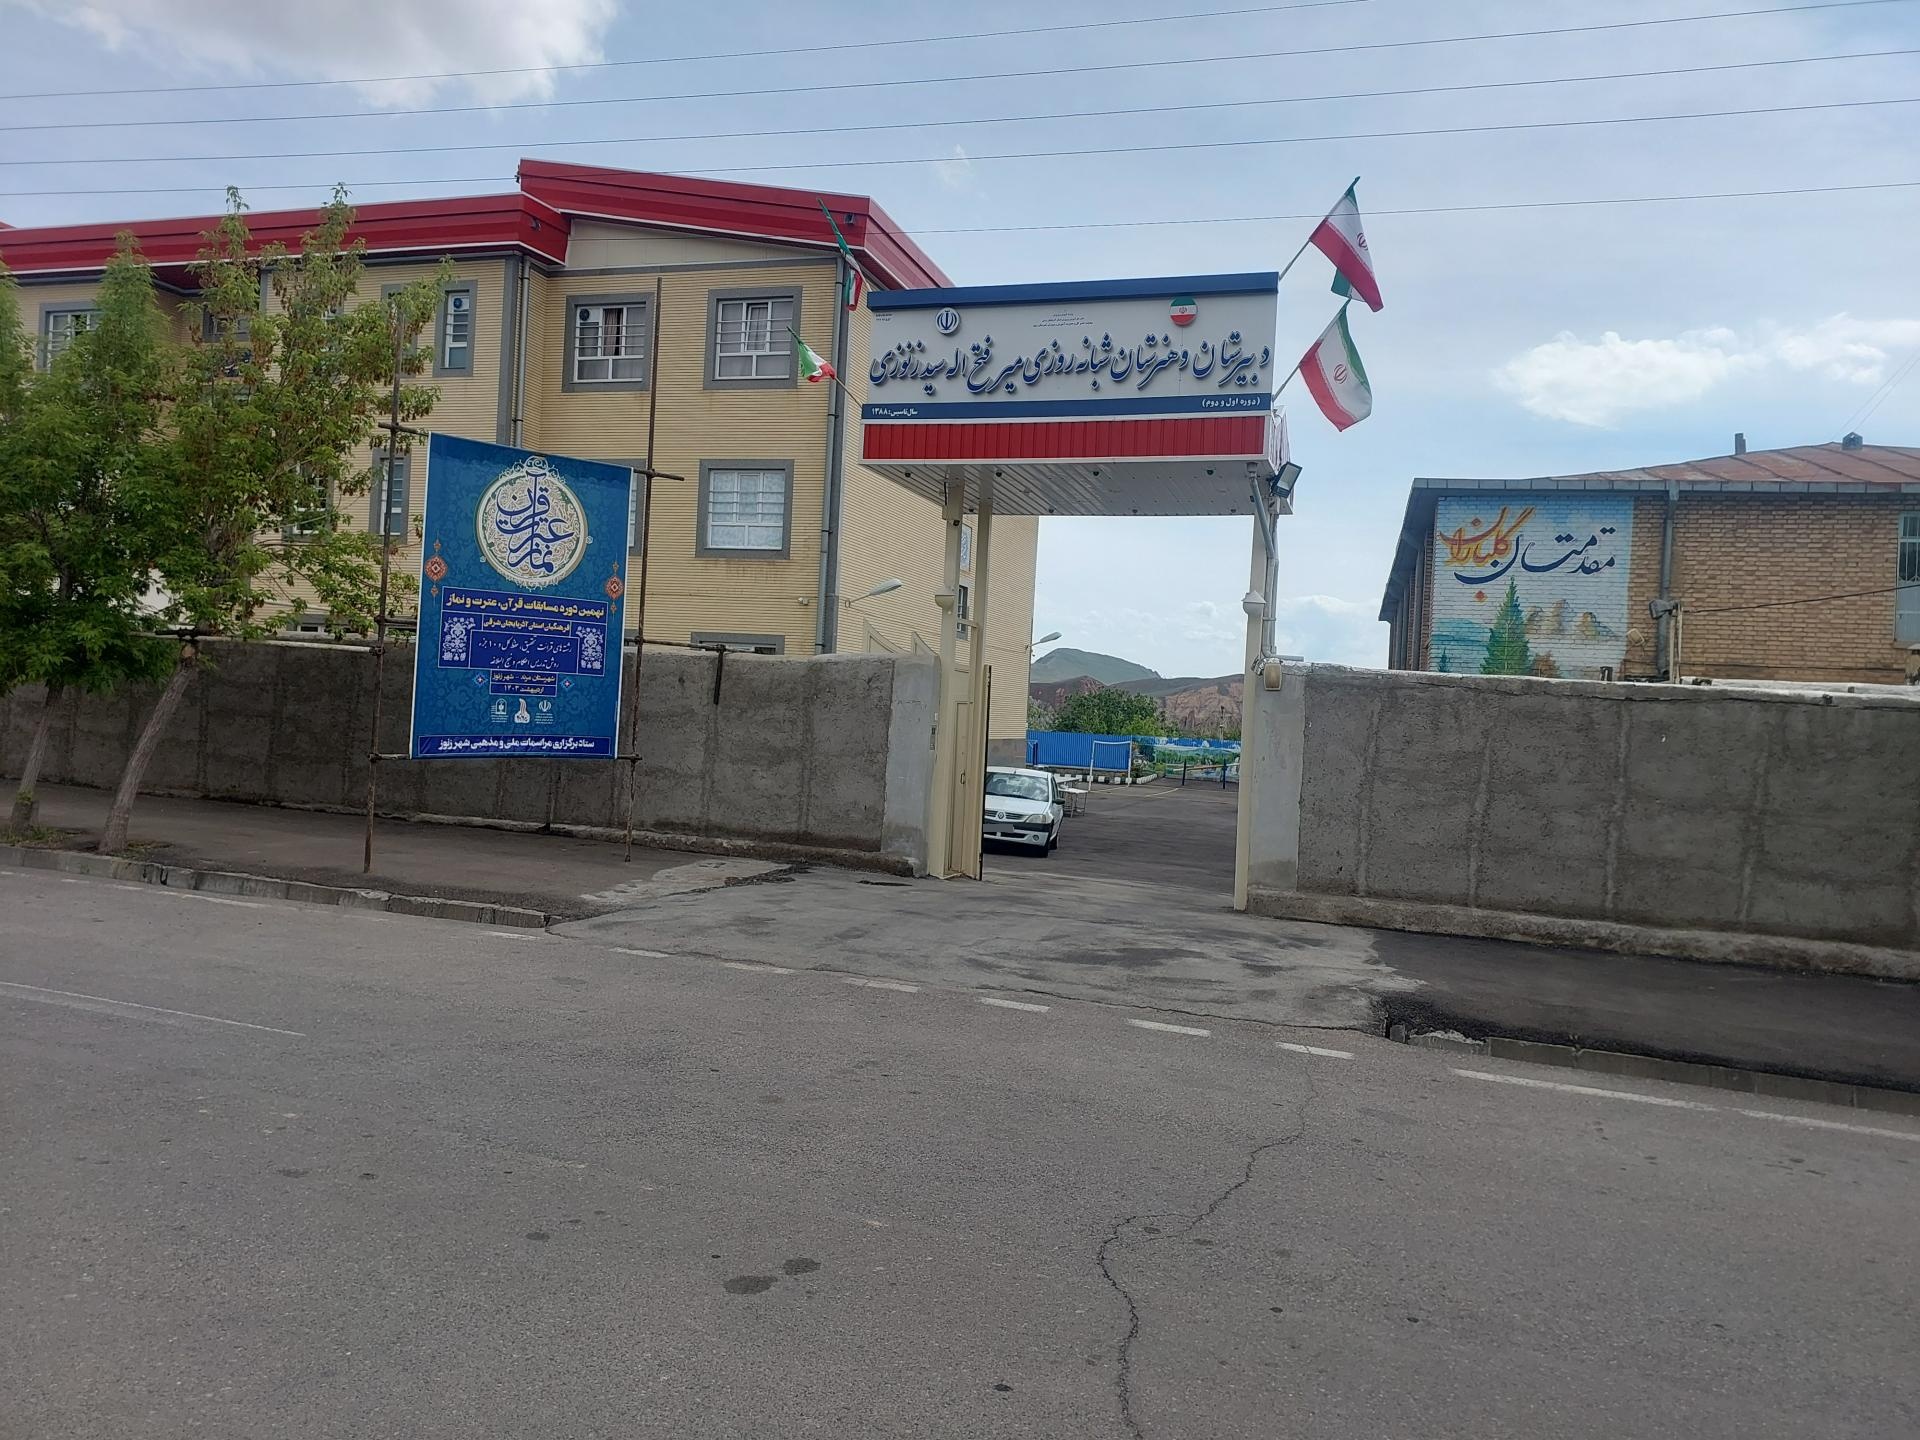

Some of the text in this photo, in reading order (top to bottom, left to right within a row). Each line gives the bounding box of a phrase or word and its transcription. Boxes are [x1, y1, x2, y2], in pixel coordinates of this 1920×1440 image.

[869, 338, 924, 385] زنوزی
[966, 335, 994, 393] فتح
[1110, 333, 1179, 390] هنرستان
[1178, 348, 1189, 370] و
[1192, 330, 1271, 387] دبیرستان
[920, 358, 946, 395] سید
[985, 355, 1023, 393] میر
[1220, 399, 1225, 407] و
[1225, 397, 1239, 407] اول
[446, 592, 466, 607] نماز
[465, 597, 472, 608] و
[472, 598, 498, 609] عترت
[524, 600, 559, 613] مسابقات
[559, 605, 578, 617] دوره
[578, 607, 605, 619] نهمین
[483, 617, 501, 628] شرقی
[528, 621, 545, 631] استان
[544, 622, 570, 633] فرهنگیان
[532, 674, 556, 683] شهرستان
[438, 737, 595, 750] ستاد برگزاری مراسمات ملی و مذهبی شهر زنوز
